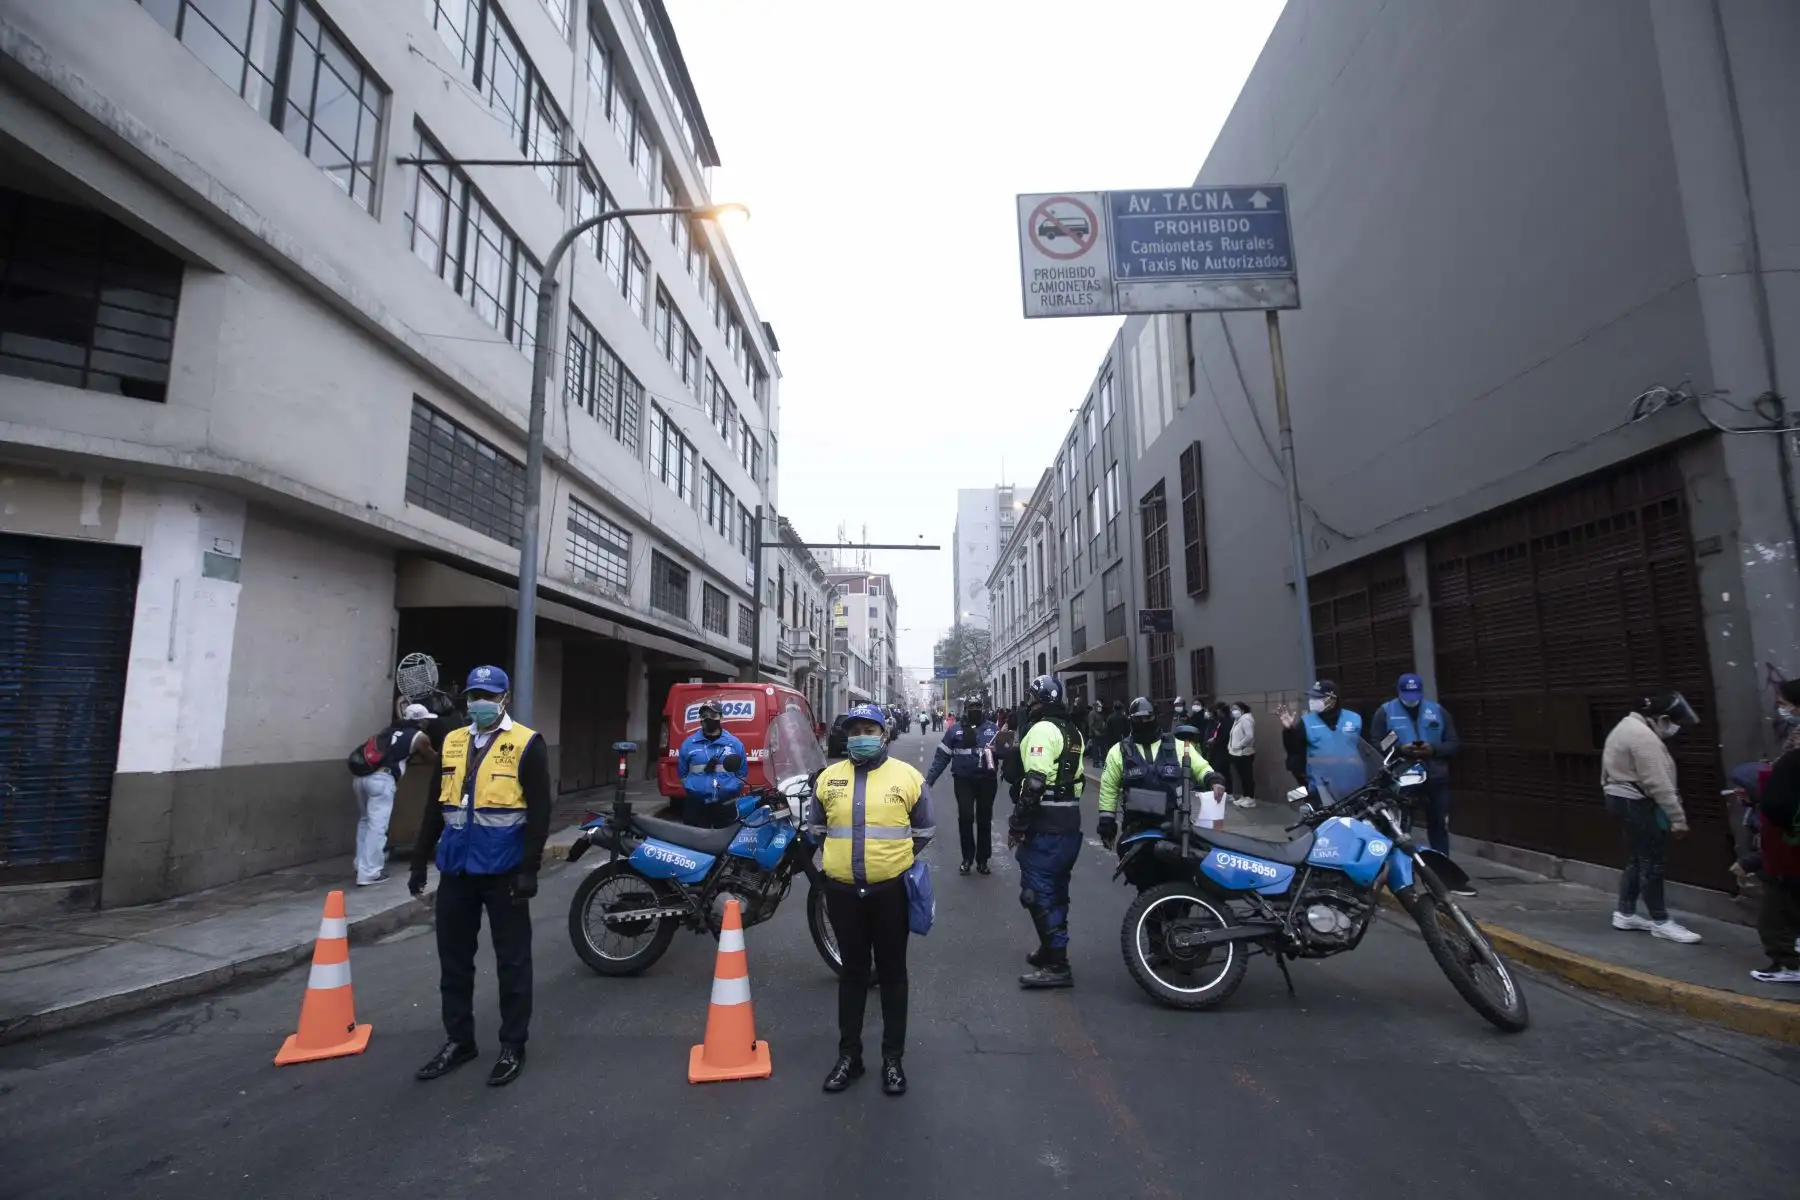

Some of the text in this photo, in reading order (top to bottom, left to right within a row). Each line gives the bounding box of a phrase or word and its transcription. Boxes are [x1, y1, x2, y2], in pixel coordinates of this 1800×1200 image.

[1129, 191, 1234, 212] Av. TACNA
[1154, 218, 1250, 235] PROHIBIDO
[1131, 236, 1275, 254] Camionetas Rurales
[1034, 266, 1096, 281] PROHIBIDO
[1122, 254, 1288, 279] y Taxis No Autorizados
[1030, 279, 1101, 294] CAMIONETAS
[1041, 293, 1094, 307] RURALES
[686, 702, 752, 721] EOSA
[655, 851, 696, 870] 318-5050
[1230, 857, 1277, 878] 318-5050
